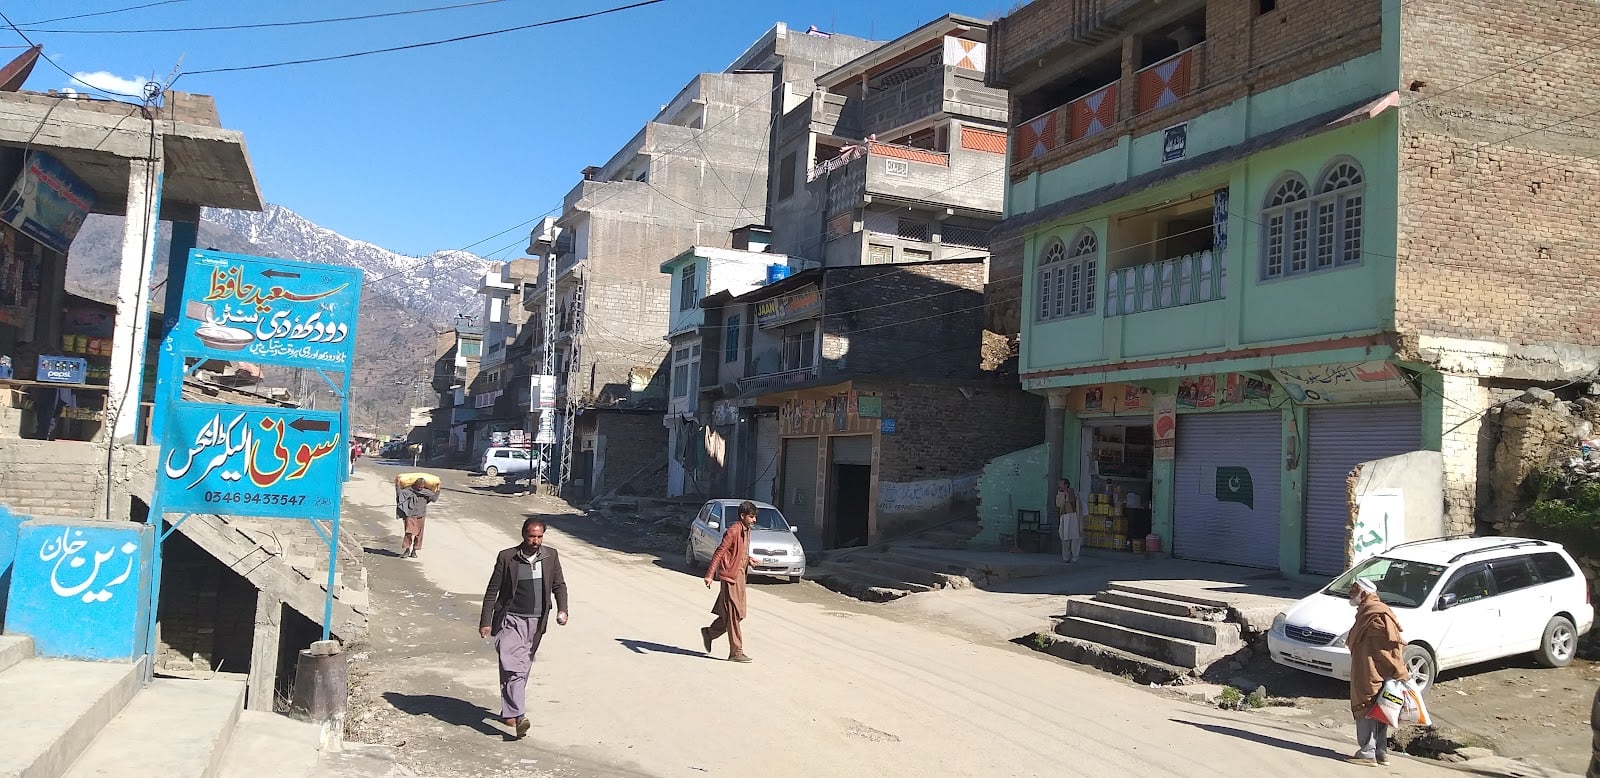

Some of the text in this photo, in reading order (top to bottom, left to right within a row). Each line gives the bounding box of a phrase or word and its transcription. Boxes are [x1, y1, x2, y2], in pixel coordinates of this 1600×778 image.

[203, 264, 349, 313] سعید حافظ
[215, 303, 258, 325] سنٹر
[757, 302, 775, 316] JAAN
[248, 415, 340, 488] سونی
[204, 490, 241, 504] 0346
[245, 492, 306, 506] 9433547
[39, 527, 138, 603] زین خان
